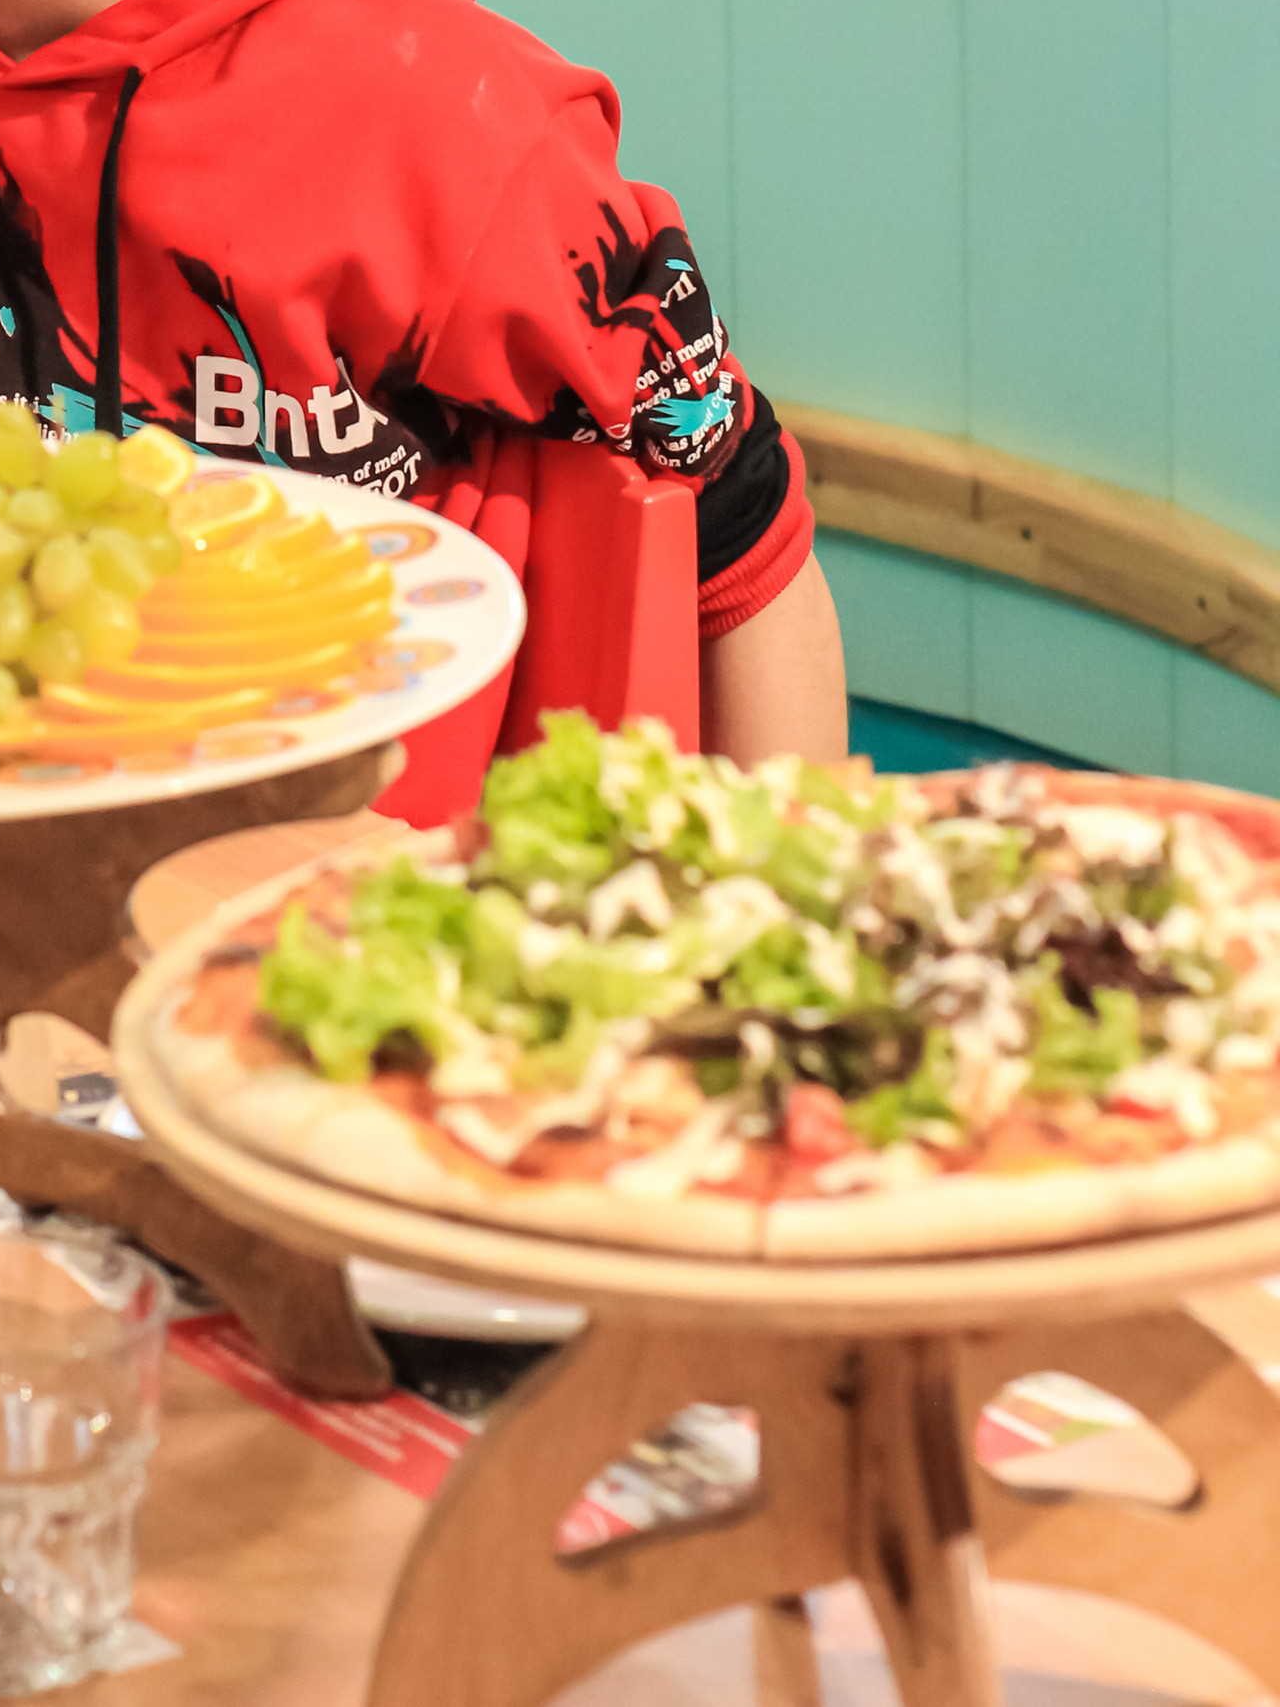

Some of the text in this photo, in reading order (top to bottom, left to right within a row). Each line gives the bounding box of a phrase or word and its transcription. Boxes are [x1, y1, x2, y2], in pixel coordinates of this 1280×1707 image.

[660, 351, 676, 375] of
[676, 333, 714, 364] men
[673, 378, 691, 395] is
[353, 460, 372, 482] of
[374, 444, 407, 474] men
[686, 444, 704, 465] of
